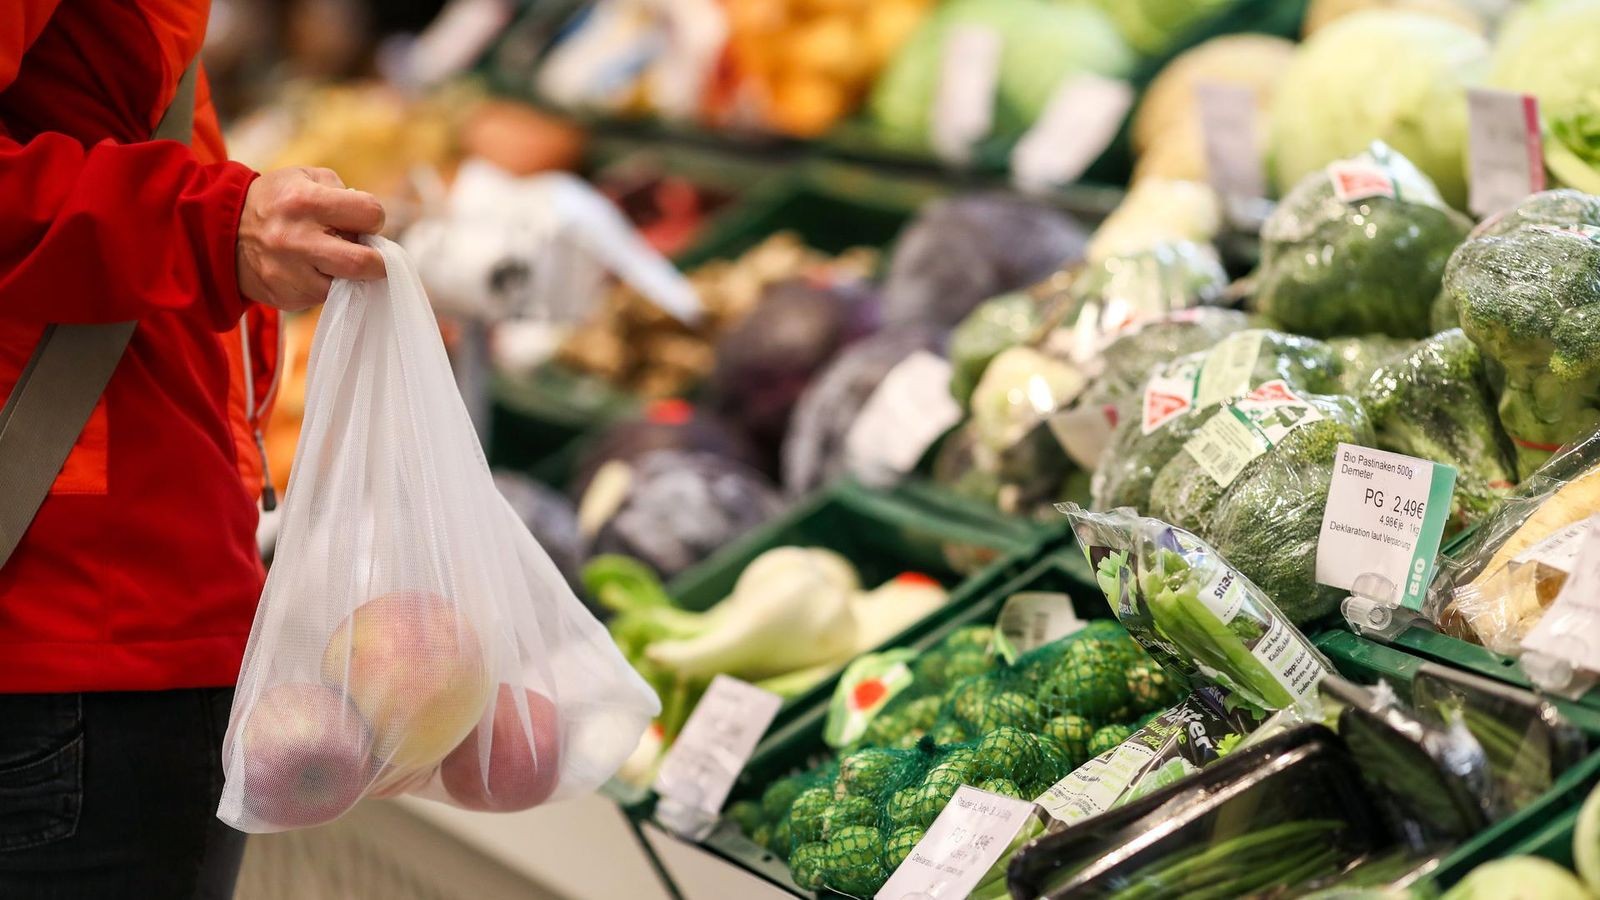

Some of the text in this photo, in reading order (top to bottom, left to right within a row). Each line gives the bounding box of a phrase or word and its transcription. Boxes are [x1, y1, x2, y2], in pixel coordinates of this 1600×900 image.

[1341, 463, 1374, 480] Demeter
[1343, 451, 1413, 480] Bio Pastinaken 500g
[1364, 487, 1425, 520] PG 2,49€
[1329, 520, 1371, 538] Deklaration
[1371, 530, 1383, 542] laut
[1408, 557, 1426, 597] BIO
